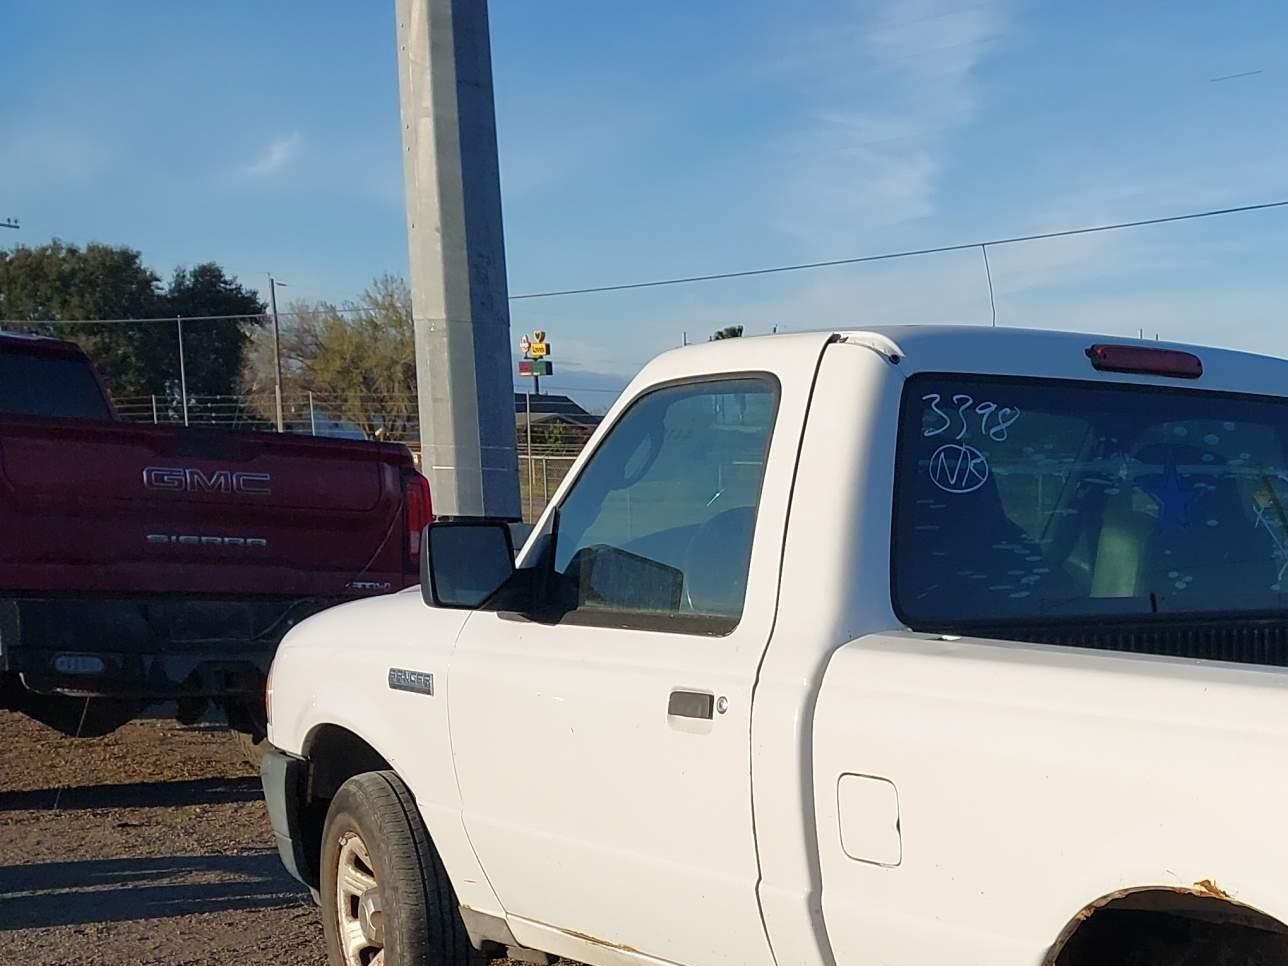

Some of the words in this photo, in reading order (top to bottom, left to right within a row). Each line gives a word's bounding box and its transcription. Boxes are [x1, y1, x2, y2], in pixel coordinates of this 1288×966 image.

[922, 393, 1020, 441] 3398
[143, 466, 272, 495] GMC
[147, 534, 267, 546] SIERRA
